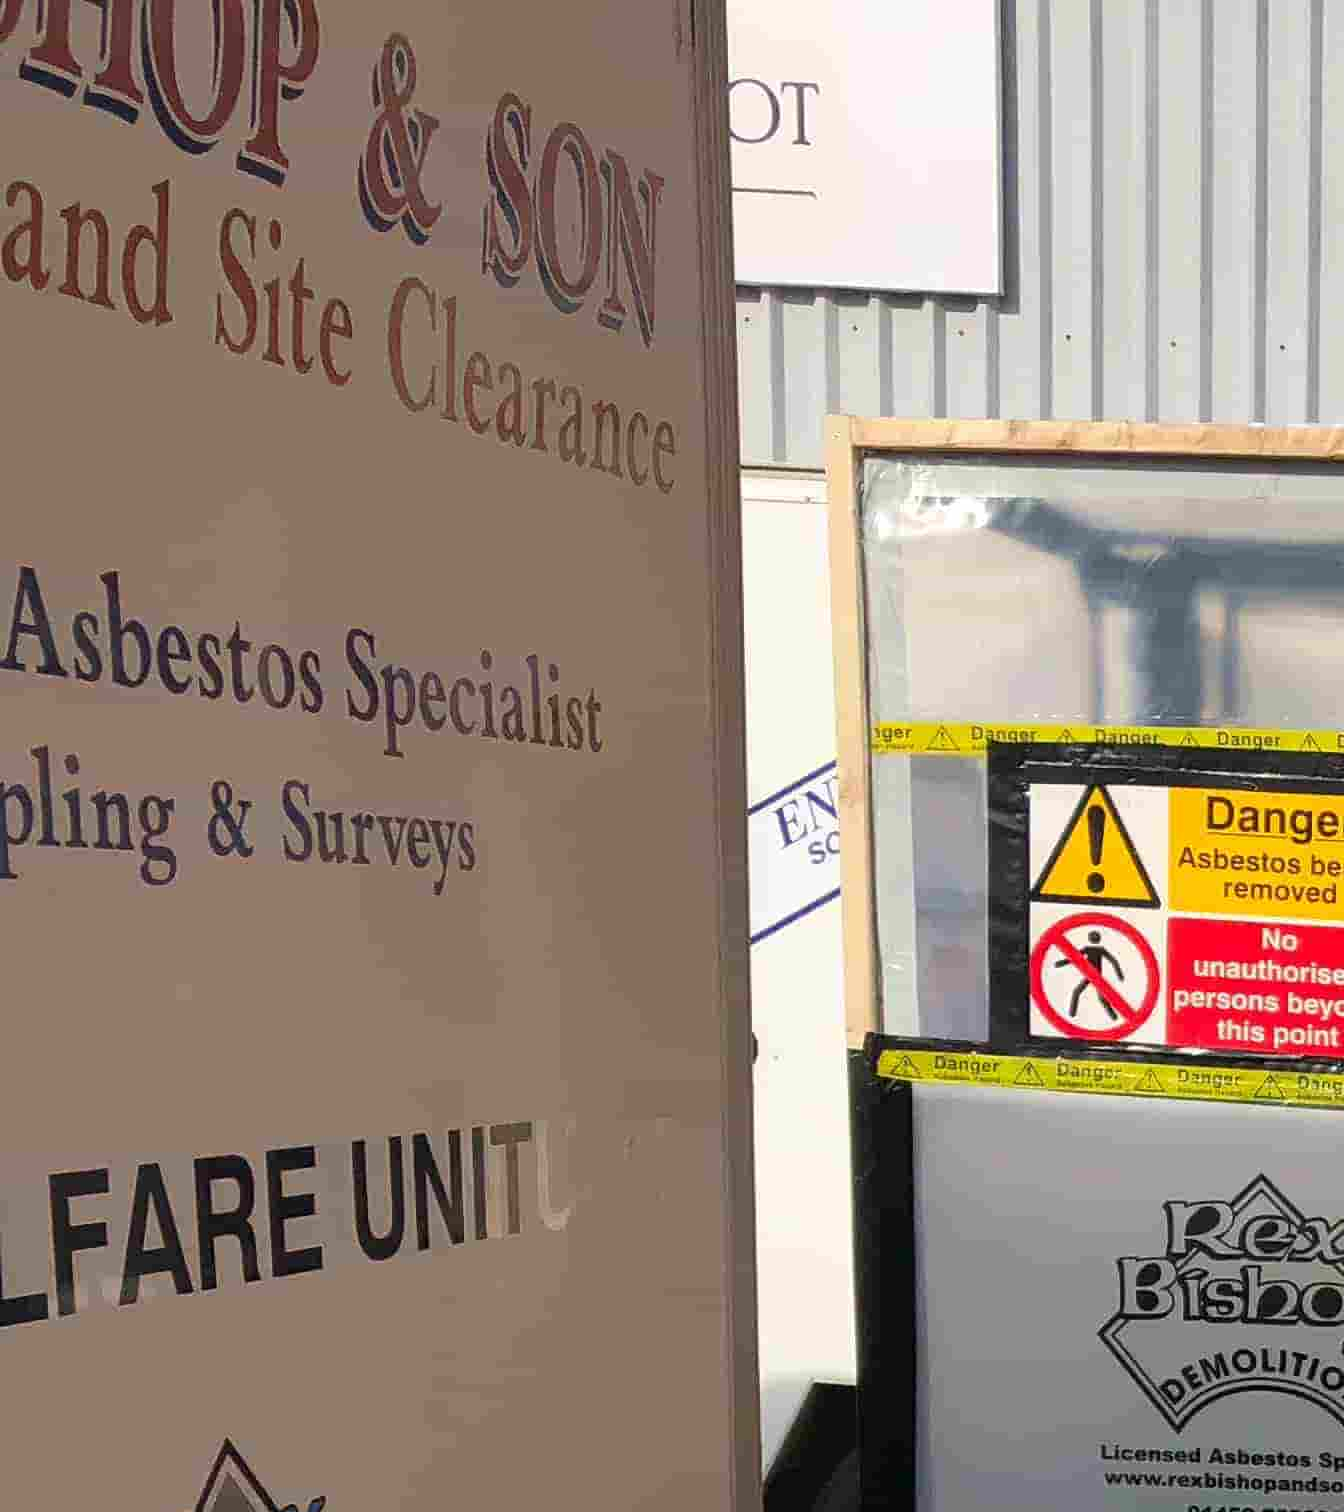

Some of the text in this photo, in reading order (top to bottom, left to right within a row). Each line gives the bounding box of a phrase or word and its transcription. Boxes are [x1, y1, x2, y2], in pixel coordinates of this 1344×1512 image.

[358, 31, 441, 245] &
[482, 92, 664, 347] SON
[3, 178, 678, 494] and Site Clearance
[0, 564, 602, 758] Asbestos Specialist
[1217, 731, 1281, 748] Danger
[207, 779, 254, 859] &
[282, 779, 476, 896] Surveys
[1178, 846, 1300, 875] Asbestos
[1223, 879, 1337, 905] removed
[1261, 928, 1298, 952] No
[1172, 989, 1280, 1015] persons
[1216, 1018, 1340, 1049] this point
[933, 1055, 999, 1074] Danger
[1057, 1062, 1121, 1081] Danger
[1177, 1069, 1241, 1088] Danger
[1100, 1444, 1201, 1464] Licensed
[1208, 1447, 1311, 1468] Asbestos
